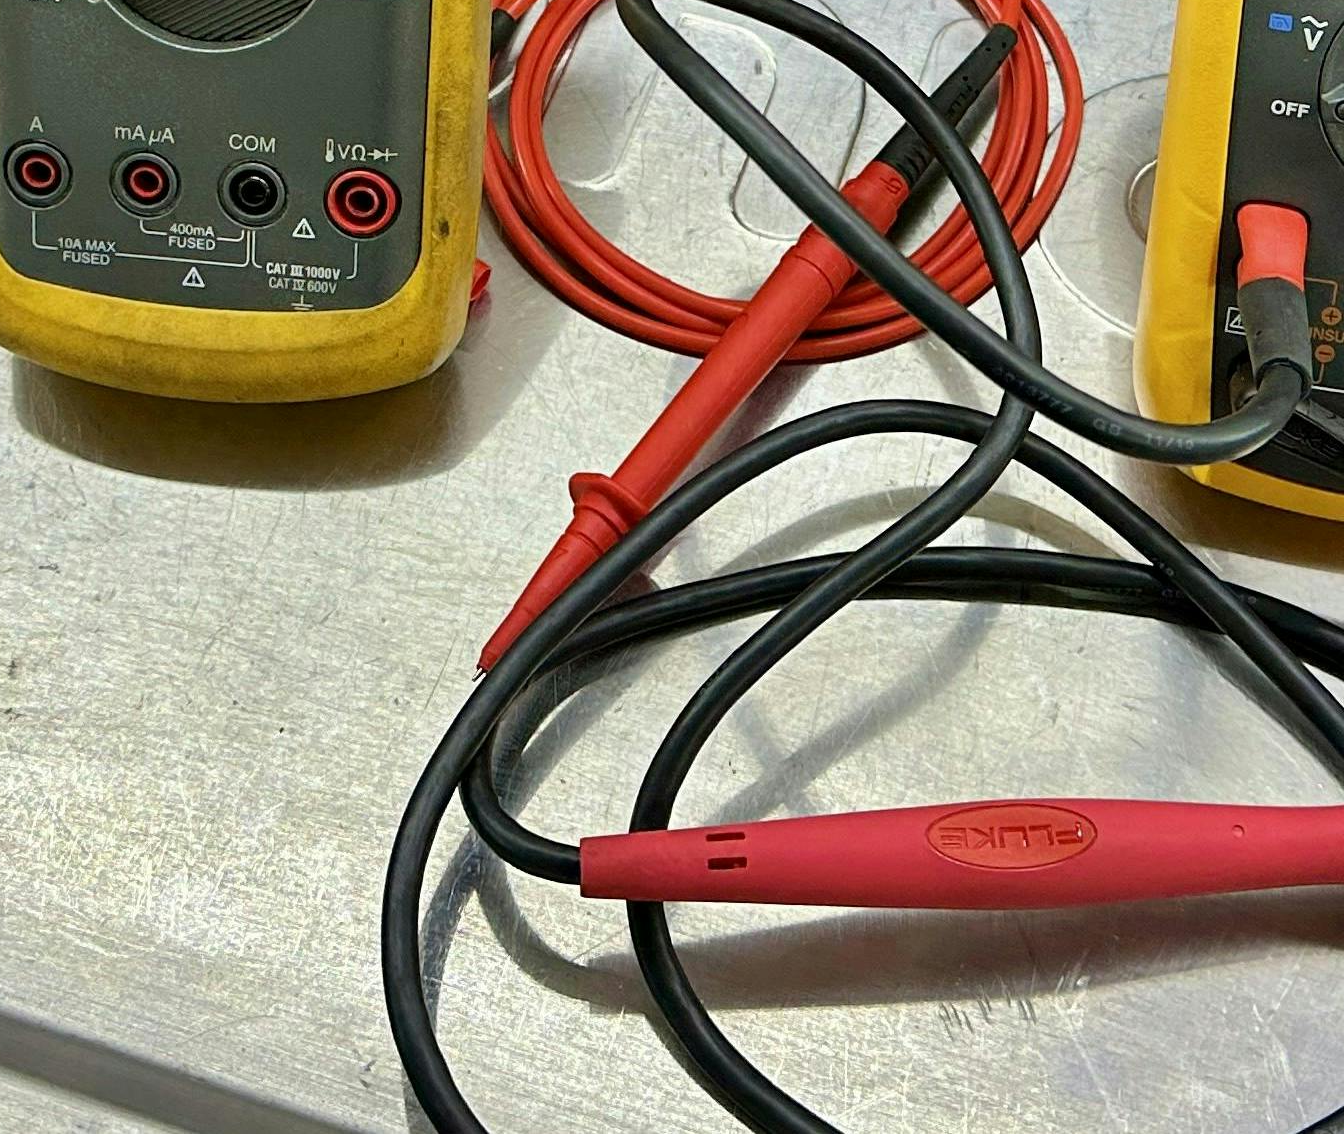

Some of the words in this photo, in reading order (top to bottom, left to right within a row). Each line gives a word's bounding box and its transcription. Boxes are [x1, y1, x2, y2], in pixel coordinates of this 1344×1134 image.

[1269, 99, 1311, 120] OFF
[29, 115, 44, 133] A
[114, 125, 145, 141] mA
[228, 133, 277, 154] COM
[169, 223, 215, 238] 400mA
[57, 236, 82, 251] 10A
[85, 238, 116, 254] MAX
[167, 236, 217, 252] FUSED
[62, 250, 111, 266] FUSED
[265, 262, 288, 277] CAT
[304, 265, 342, 281] 1000V
[268, 276, 291, 291] CAT
[307, 279, 338, 295] 600V
[938, 819, 1084, 850] FLUKE
